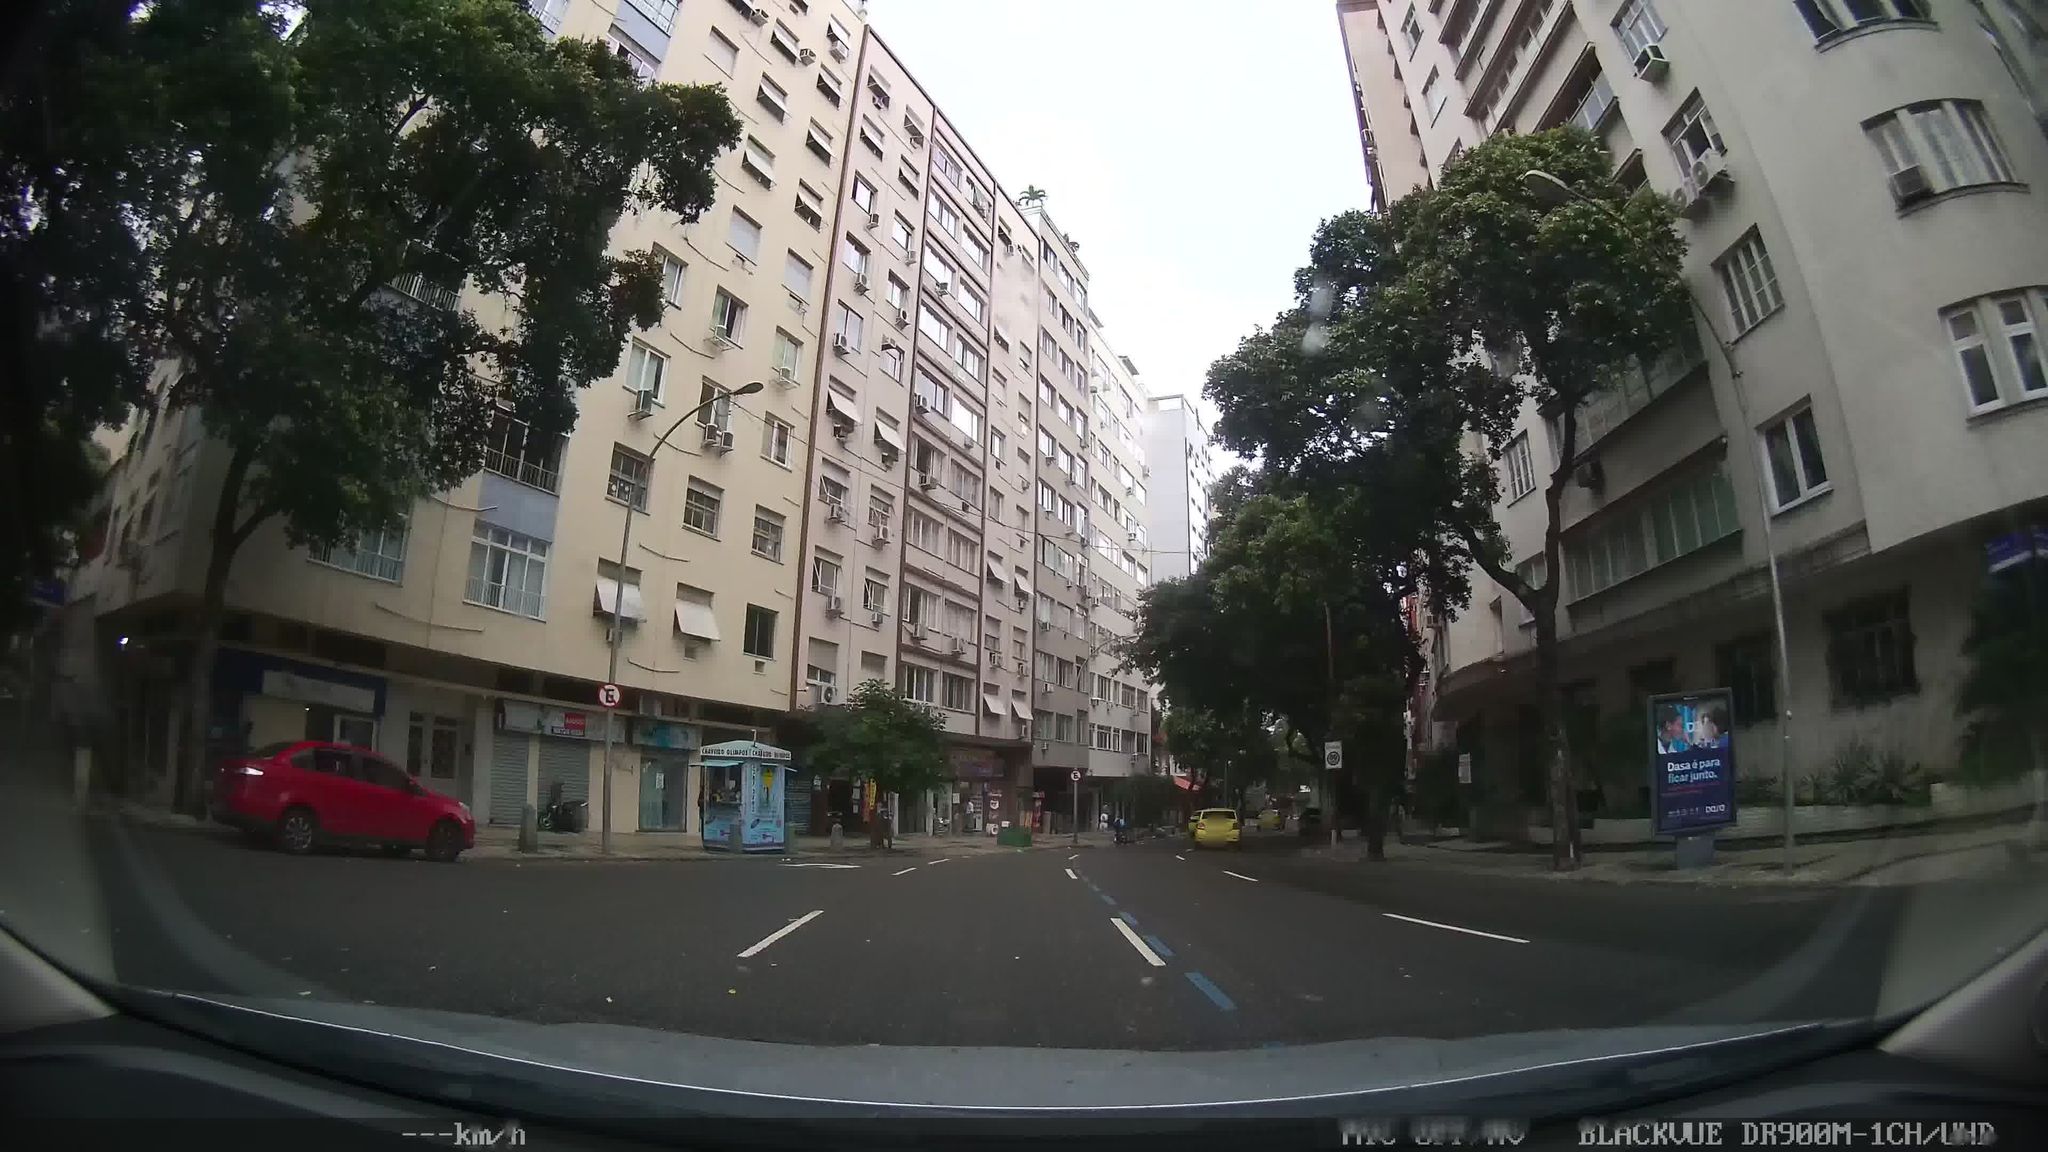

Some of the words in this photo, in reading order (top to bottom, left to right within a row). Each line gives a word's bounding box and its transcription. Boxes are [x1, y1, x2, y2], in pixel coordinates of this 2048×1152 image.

[1667, 762, 1691, 772] Dasa
[1699, 759, 1721, 770] para
[1668, 773, 1689, 784] ficar
[1690, 770, 1718, 783] junto.
